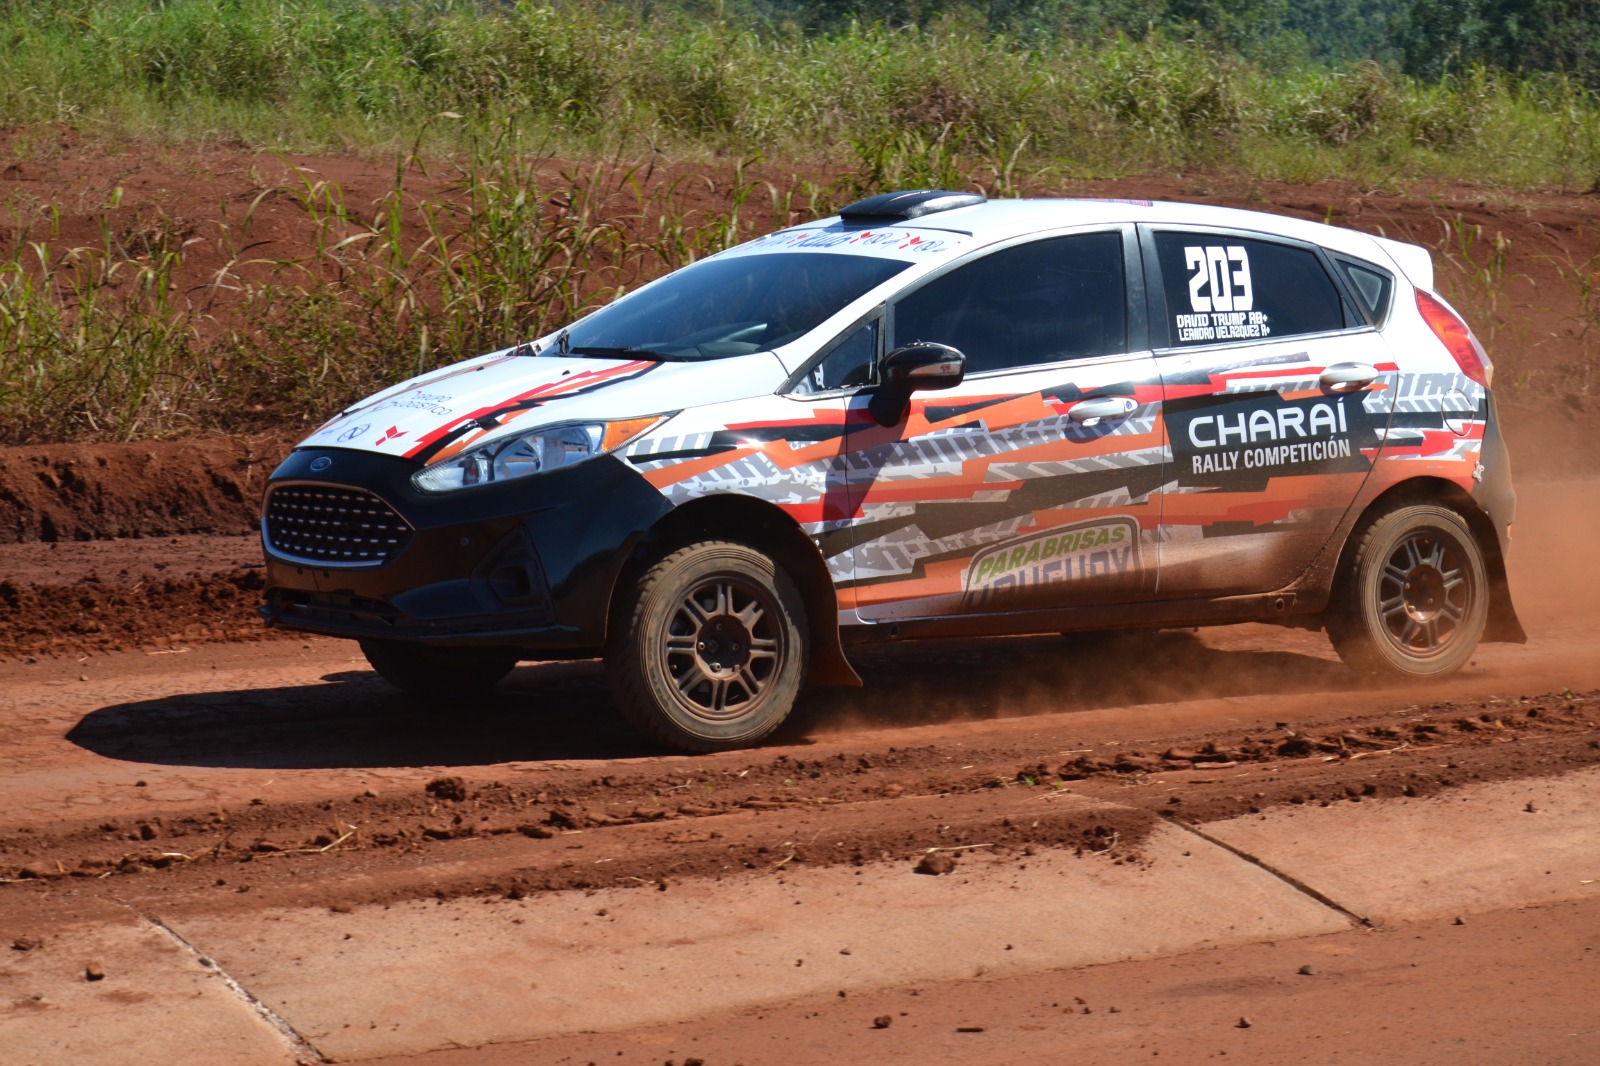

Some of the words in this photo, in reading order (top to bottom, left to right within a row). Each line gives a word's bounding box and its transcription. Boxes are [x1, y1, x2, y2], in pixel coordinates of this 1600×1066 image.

[1184, 246, 1253, 312] 203
[1176, 314, 1209, 328] DAVID
[1211, 312, 1246, 326] TRUMP
[1178, 327, 1215, 342] LEANDRO
[1215, 324, 1260, 339] VELAZQUEZ
[1261, 323, 1270, 336] A+
[1188, 397, 1347, 448] CHARAÍ
[1192, 451, 1239, 474] RALLY
[1244, 435, 1351, 469] COMPETICIÓN
[974, 526, 1126, 584] PARABRISAS
